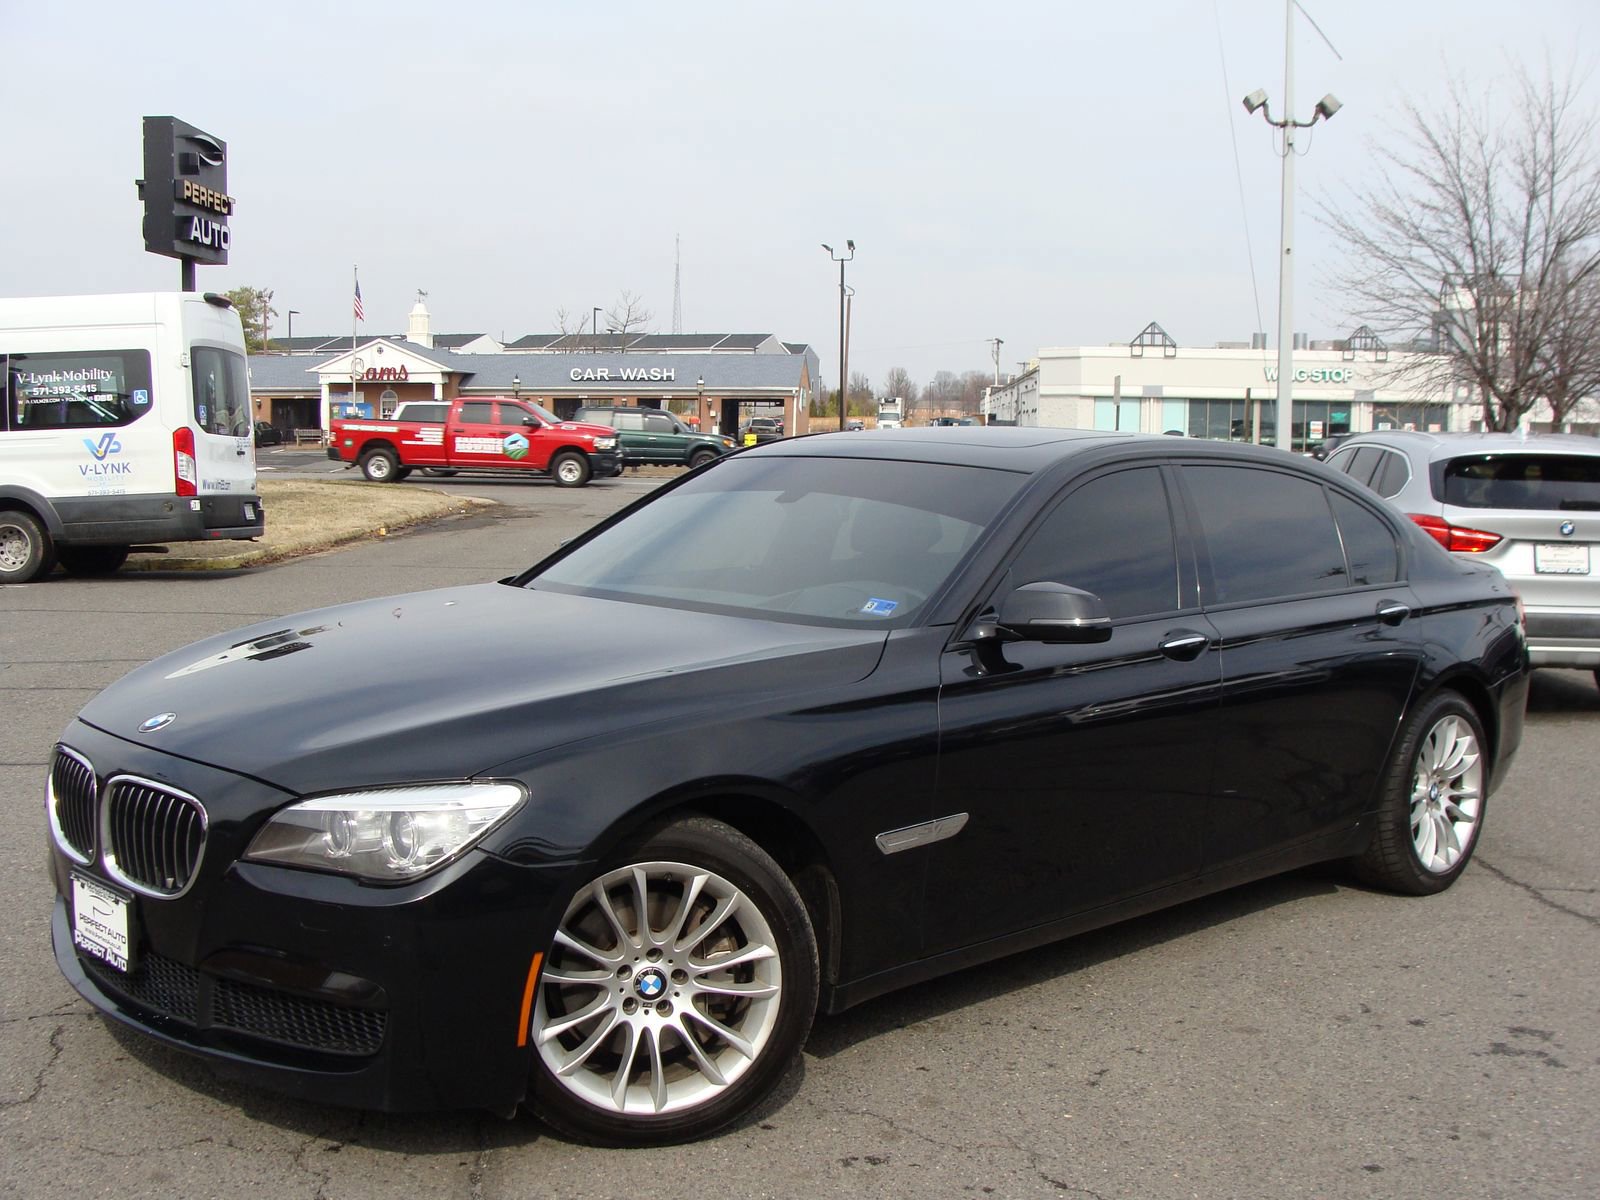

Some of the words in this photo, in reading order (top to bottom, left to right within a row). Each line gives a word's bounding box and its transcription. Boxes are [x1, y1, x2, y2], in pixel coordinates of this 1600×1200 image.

[183, 180, 236, 216] PERFECT
[190, 216, 231, 250] AUTO
[17, 370, 62, 386] V-Lynk
[63, 367, 113, 381] Mobility
[570, 368, 609, 380] CAR
[620, 368, 675, 381] WASH
[79, 462, 131, 476] V-LYNK
[79, 912, 108, 933] PERFECT
[107, 929, 127, 945] AUTO
[106, 948, 127, 972] AUTO
